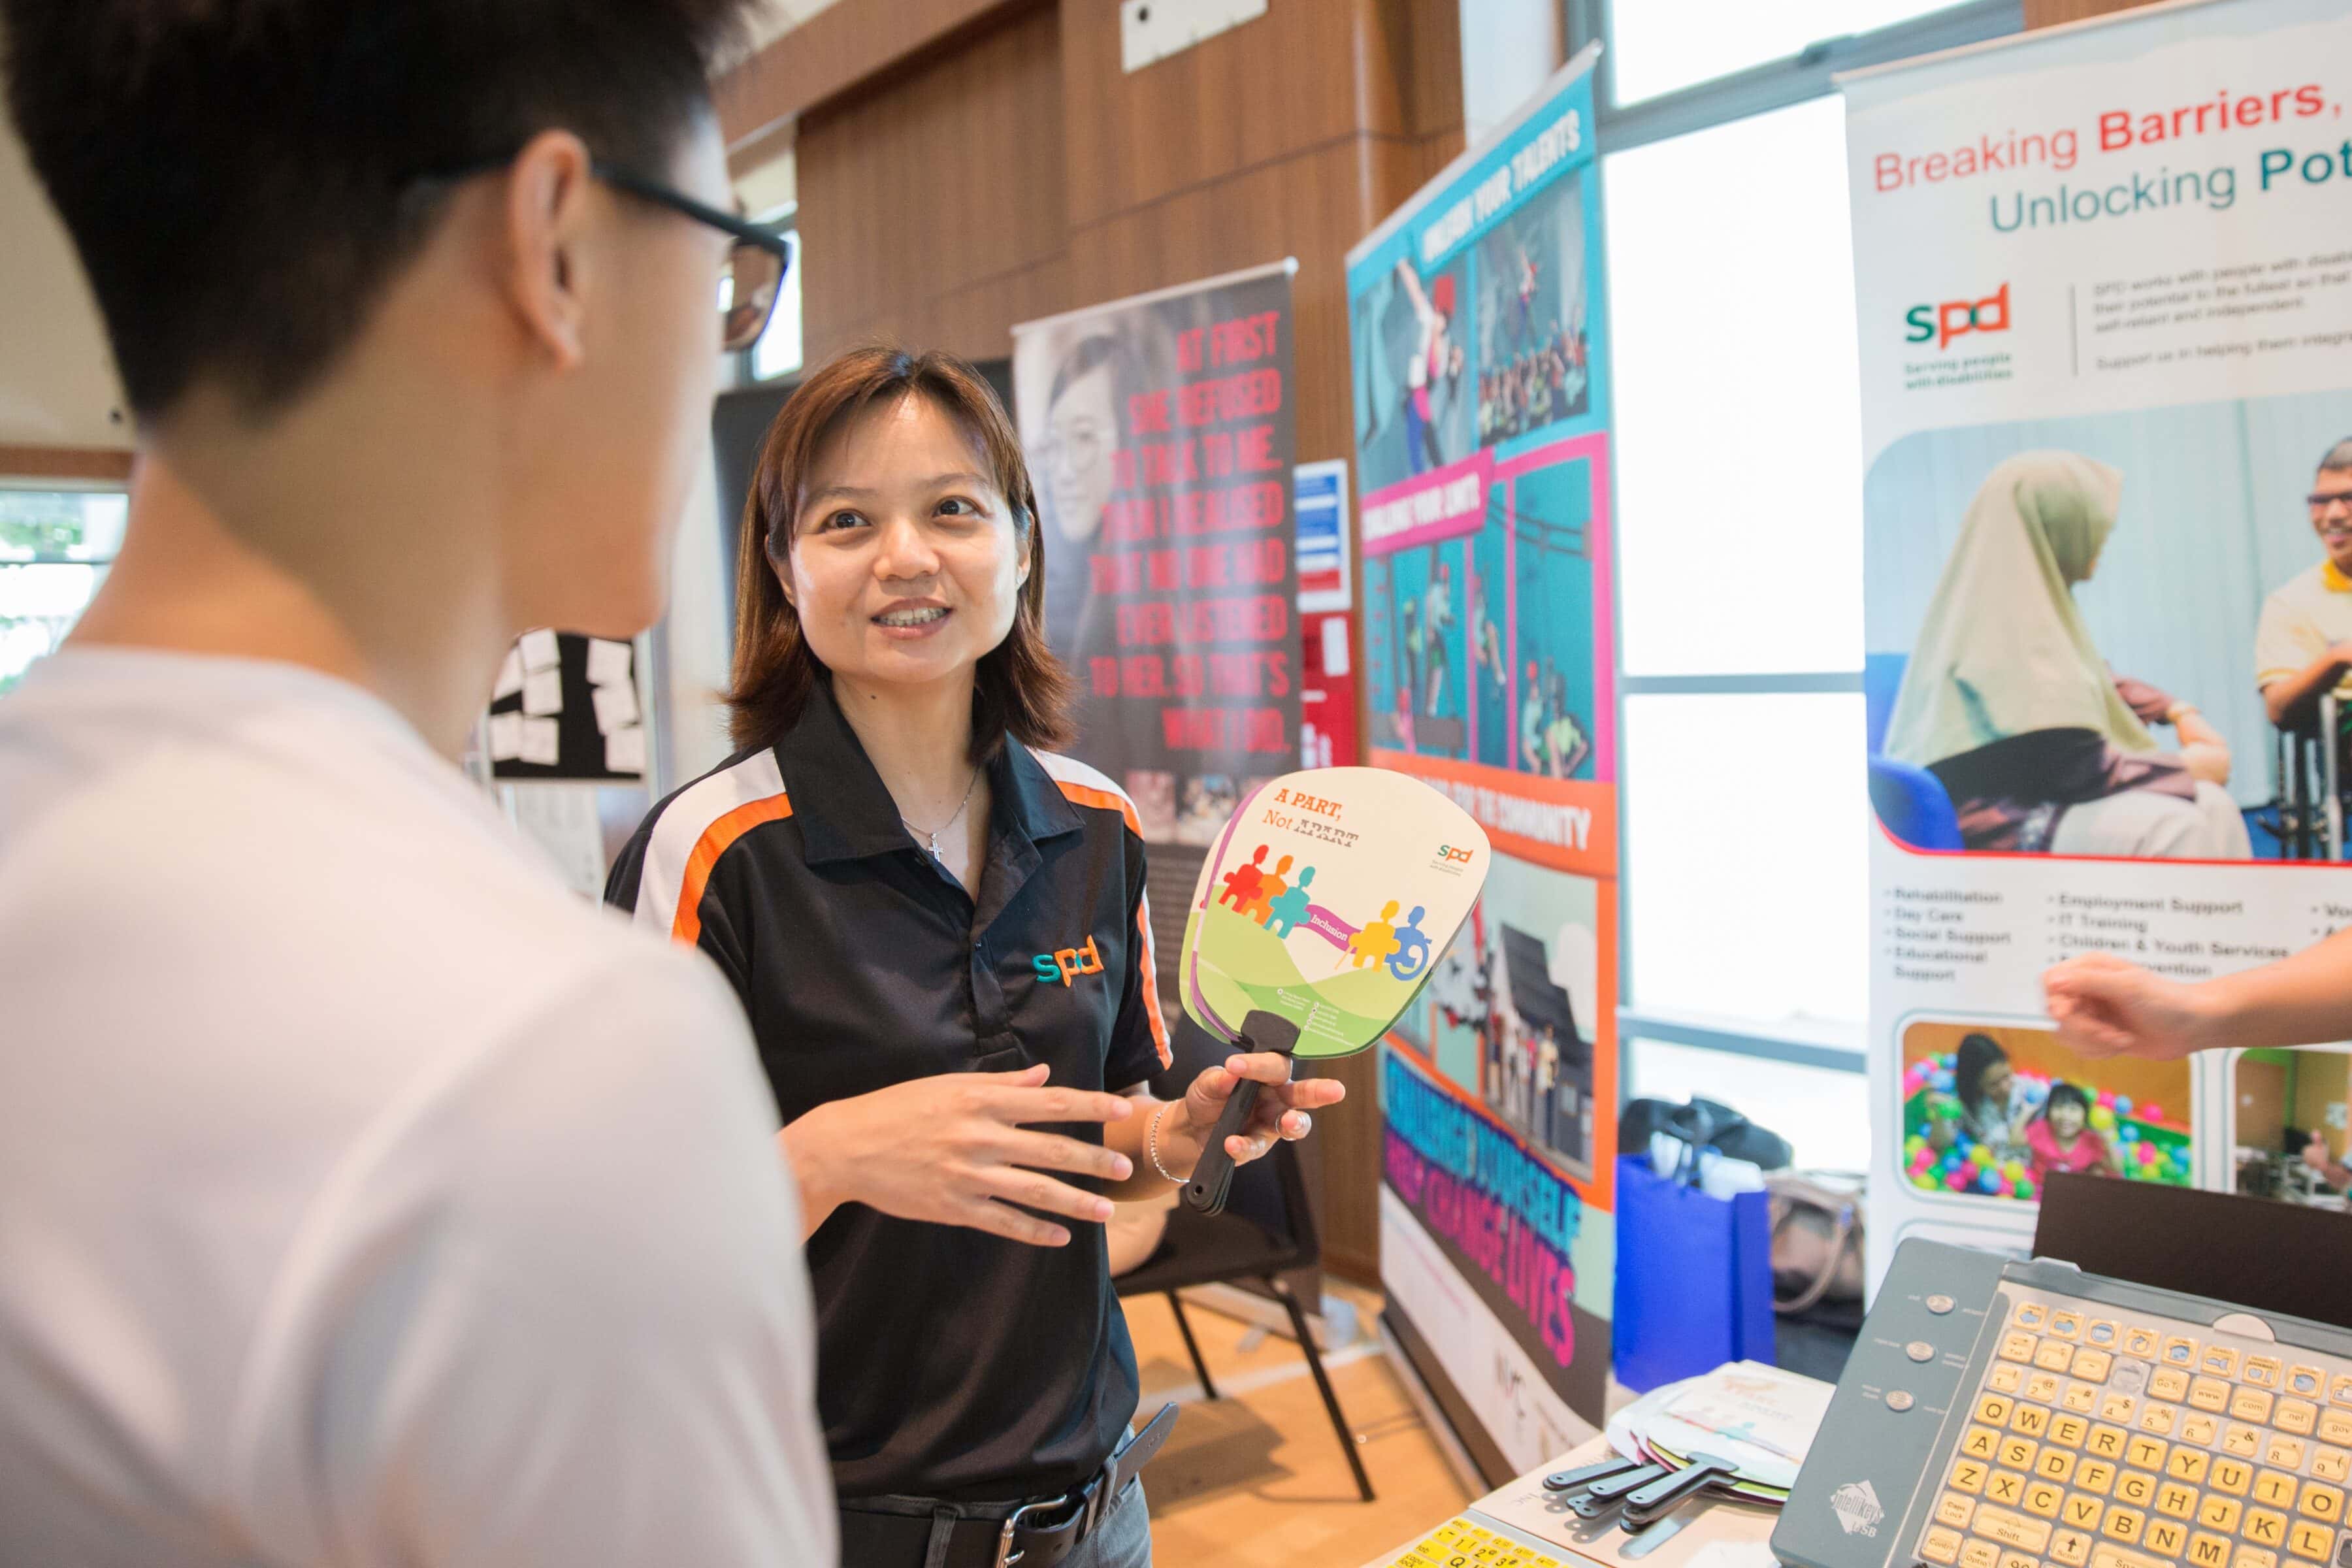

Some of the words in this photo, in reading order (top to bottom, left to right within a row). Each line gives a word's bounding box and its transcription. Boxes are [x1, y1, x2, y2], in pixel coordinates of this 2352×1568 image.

[1873, 129, 2078, 193] Breaking
[2097, 83, 2342, 152] Barriers,
[1990, 165, 2236, 233] Unlocking
[1904, 282, 2010, 351] spd
[1211, 310, 1279, 368] FIRST
[1128, 389, 1171, 436] SHE
[1274, 788, 1290, 803] A
[1291, 792, 1343, 821] PART,
[1262, 809, 1293, 830] Not
[1498, 791, 1593, 852] COMMUNITY
[1437, 844, 1474, 863] spd
[1895, 888, 2003, 904] Rehabilitation
[2059, 894, 2164, 911] Employment
[2170, 897, 2244, 915] Support
[1895, 907, 1922, 923] Day
[1927, 909, 1965, 921] Care
[2080, 913, 2148, 933] Training
[1310, 914, 1348, 941] Inclusion
[1895, 927, 1941, 941] Social
[1946, 928, 2012, 945] Support
[1895, 946, 1989, 963] Educational
[2061, 934, 2129, 948] Children
[2136, 939, 2147, 950] &
[2154, 938, 2204, 953] Youth
[2212, 942, 2289, 957] Services
[1032, 934, 1105, 987] spd
[1895, 966, 1955, 981] Support
[1475, 1116, 1582, 1260] YOURSELF
[1506, 1211, 1576, 1369] LIVES
[2031, 1386, 2039, 1395] 2
[2198, 1390, 2220, 1400] www
[2068, 1396, 2076, 1405] 3
[2122, 1399, 2131, 1409] $
[2146, 1417, 2153, 1426] 5
[2186, 1428, 2195, 1437] 6
[2229, 1439, 2236, 1448] 7
[2244, 1431, 2255, 1443] &
[1986, 1403, 2002, 1419] Q
[2021, 1411, 2040, 1429] W
[2059, 1422, 2077, 1441] E
[2097, 1433, 2115, 1452] R
[2141, 1444, 2156, 1462] T
[2181, 1455, 2198, 1473] Y
[2221, 1467, 2240, 1486] U
[2272, 1481, 2279, 1499] I
[2311, 1494, 2332, 1512] O
[2271, 1451, 2280, 1461] 8
[2317, 1463, 2326, 1473] 9
[1972, 1435, 1987, 1452] A
[2010, 1446, 2026, 1462] S
[2048, 1456, 2065, 1474] D
[2087, 1467, 2104, 1484] F
[2126, 1480, 2144, 1498] G
[2166, 1491, 2187, 1511] H
[2211, 1507, 2228, 1523] J
[2255, 1517, 2275, 1539] K
[2303, 1531, 2319, 1553] L
[1959, 1467, 1978, 1486] Z
[1996, 1478, 2014, 1498] X
[2034, 1491, 2052, 1509] C
[2076, 1501, 2093, 1520] V
[2114, 1515, 2133, 1534] B
[2155, 1527, 2176, 1548] N
[2197, 1541, 2221, 1563] M
[1851, 1521, 1877, 1537] USB
[1996, 1527, 2020, 1542] Shift
[1474, 1548, 1486, 1558] 2
[1450, 1557, 1465, 1568] Q
[1495, 1558, 1507, 1567] 3
